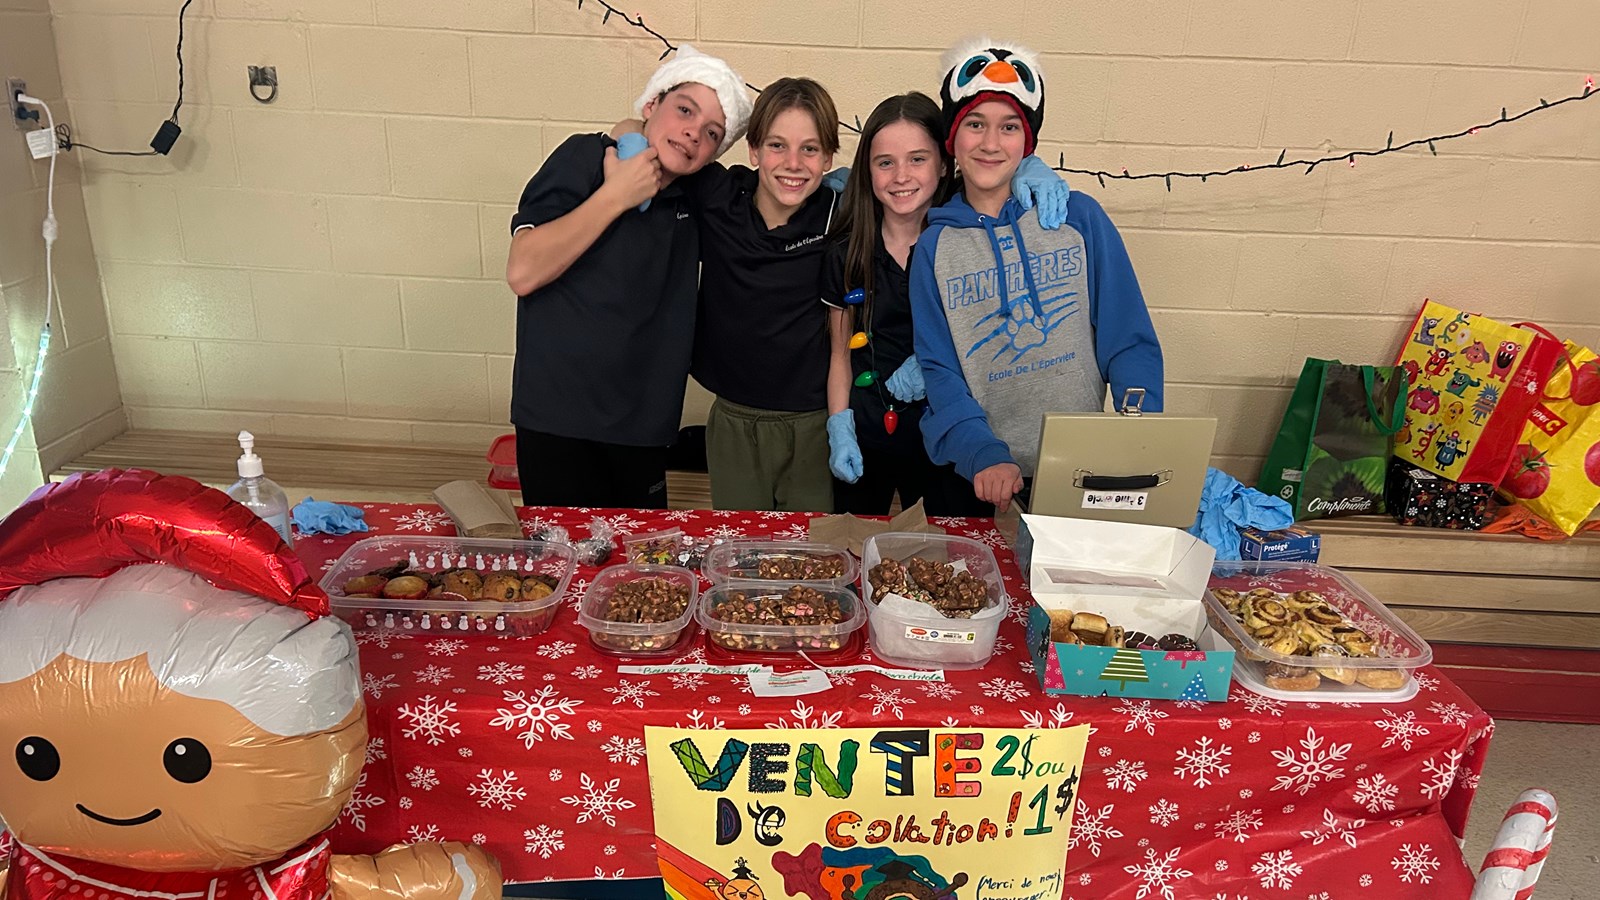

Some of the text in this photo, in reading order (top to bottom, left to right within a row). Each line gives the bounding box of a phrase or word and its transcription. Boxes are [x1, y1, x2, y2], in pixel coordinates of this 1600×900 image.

[1015, 365, 1028, 374] De
[1532, 408, 1560, 431] uper C
[1137, 495, 1144, 506] 3
[1307, 497, 1372, 515] Compliments
[1245, 541, 1251, 553] L
[1263, 541, 1289, 553] Protégé
[1311, 540, 1317, 548] L
[669, 730, 984, 799] VENTE
[1035, 761, 1066, 778] ou
[1020, 877, 1032, 889] de
